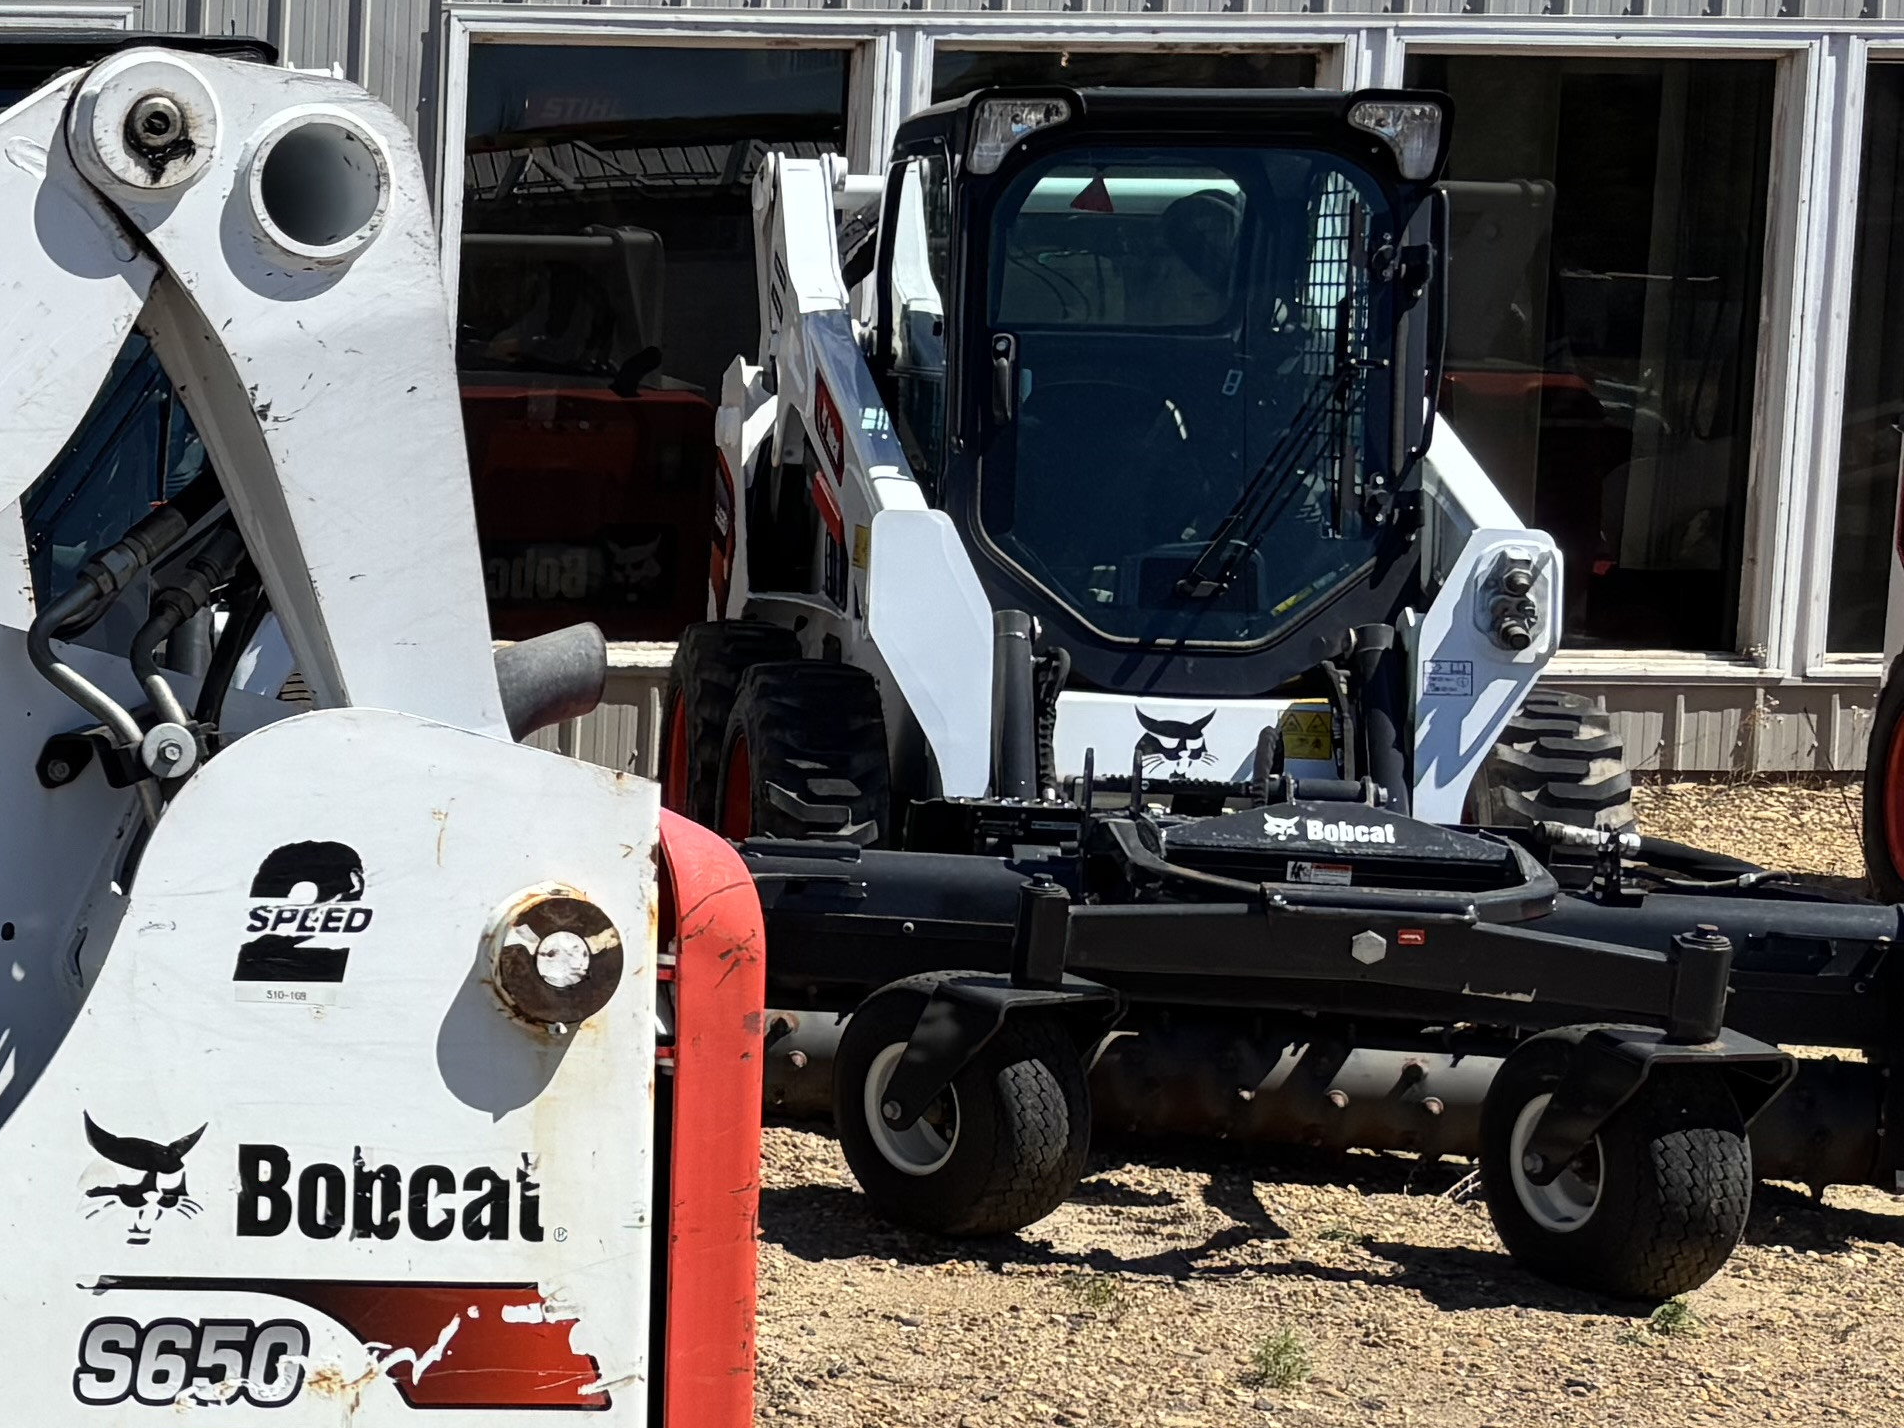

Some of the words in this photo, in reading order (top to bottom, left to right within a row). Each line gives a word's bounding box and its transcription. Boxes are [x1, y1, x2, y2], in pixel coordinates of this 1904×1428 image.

[1306, 820, 1395, 843] Bobcat
[246, 906, 373, 933] SPEED
[237, 1144, 544, 1242] Bobcat
[73, 1317, 310, 1408] S650
